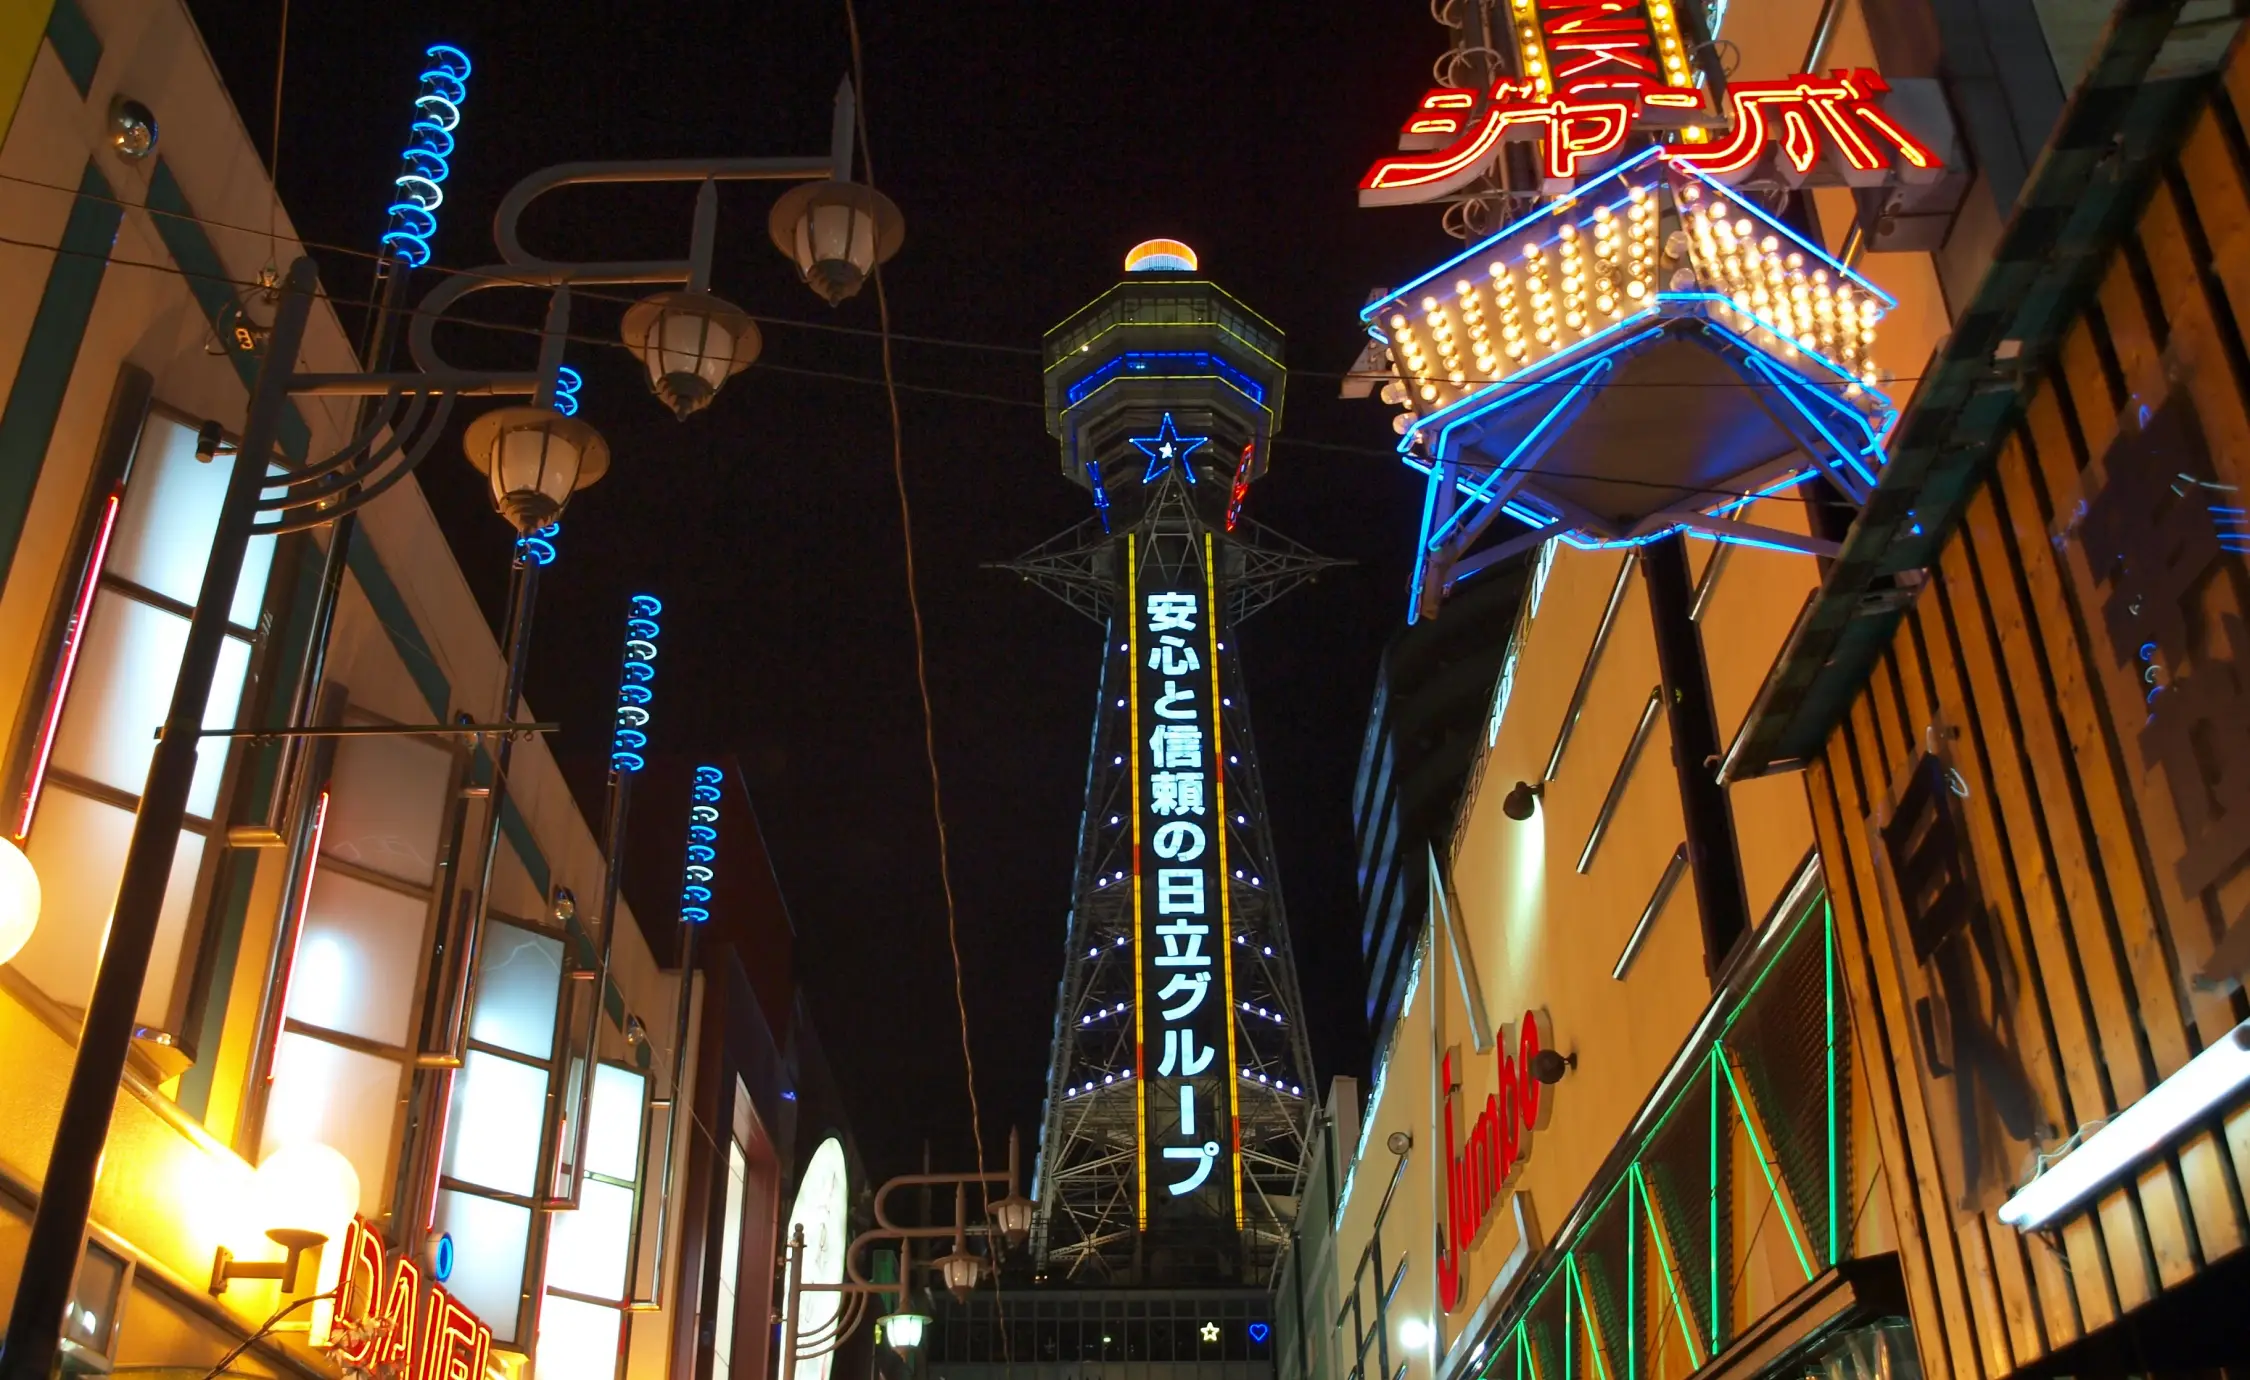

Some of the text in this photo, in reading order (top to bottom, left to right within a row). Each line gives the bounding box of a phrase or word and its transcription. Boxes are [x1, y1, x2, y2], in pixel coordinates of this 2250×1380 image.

[1359, 67, 1943, 189] ジャンボ
[1146, 592, 1220, 1196] 安心と信頼の日立グループ
